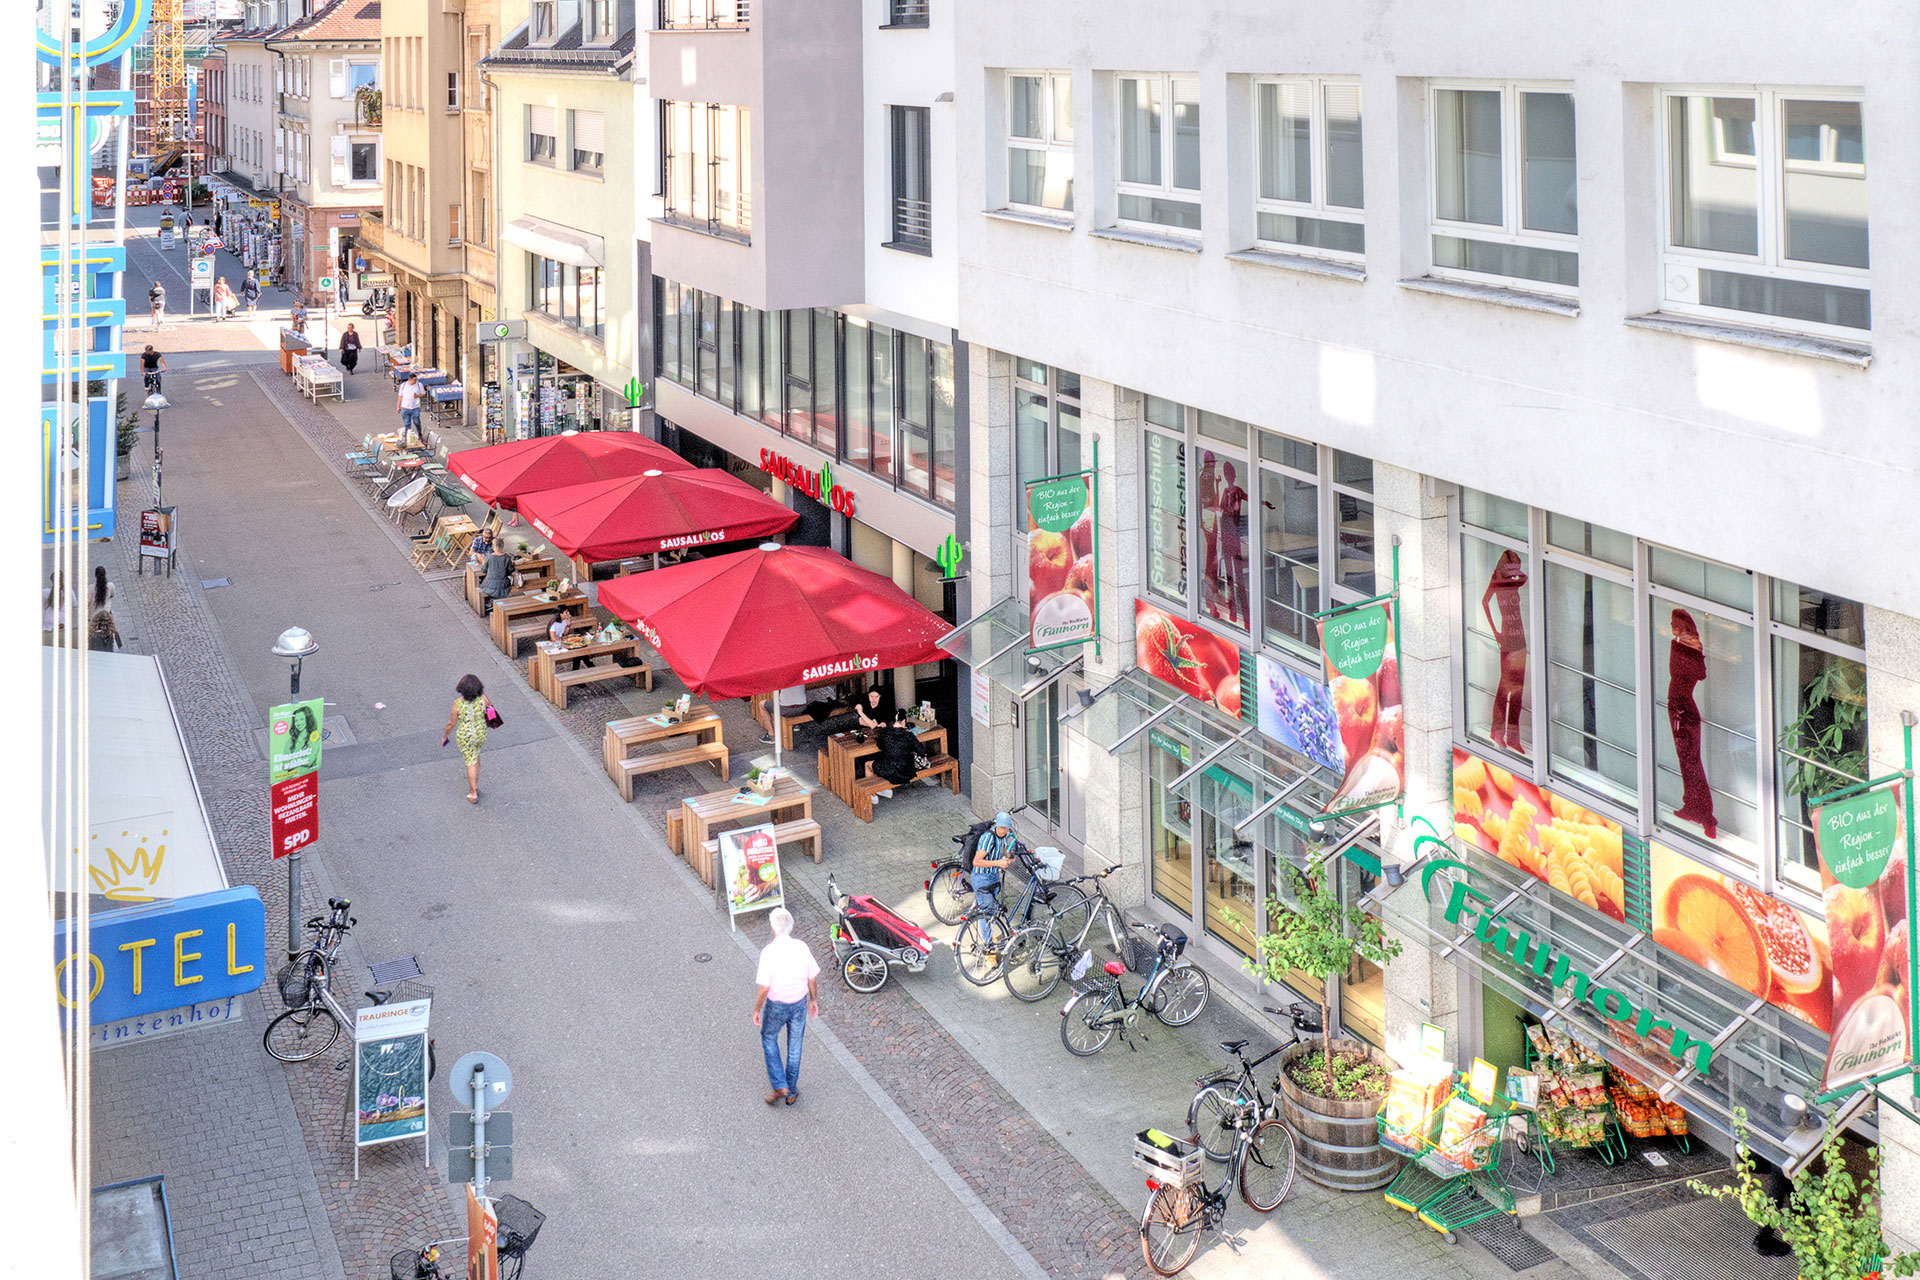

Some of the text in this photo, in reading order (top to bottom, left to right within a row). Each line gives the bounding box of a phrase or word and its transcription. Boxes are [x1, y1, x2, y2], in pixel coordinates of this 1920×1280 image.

[1037, 489, 1055, 499] BIO
[1043, 501, 1068, 511] Region
[1150, 433, 1164, 588] Sprachschule
[1038, 510, 1080, 524] einfach besser
[1042, 622, 1089, 637] Füllhorn
[1330, 616, 1382, 637] BIO aus der
[1341, 637, 1369, 650] Region
[1338, 654, 1363, 669] einfach
[287, 791, 305, 803] MEHR
[1827, 802, 1888, 831] BIO aus der
[283, 829, 310, 850] SPD
[1839, 831, 1874, 850] Region
[1834, 845, 1890, 874] einfach besser
[1443, 880, 1713, 1075] Füllhorn
[359, 1008, 409, 1022] TRAURINGE
[1839, 1039, 1902, 1072] Füllhorn
